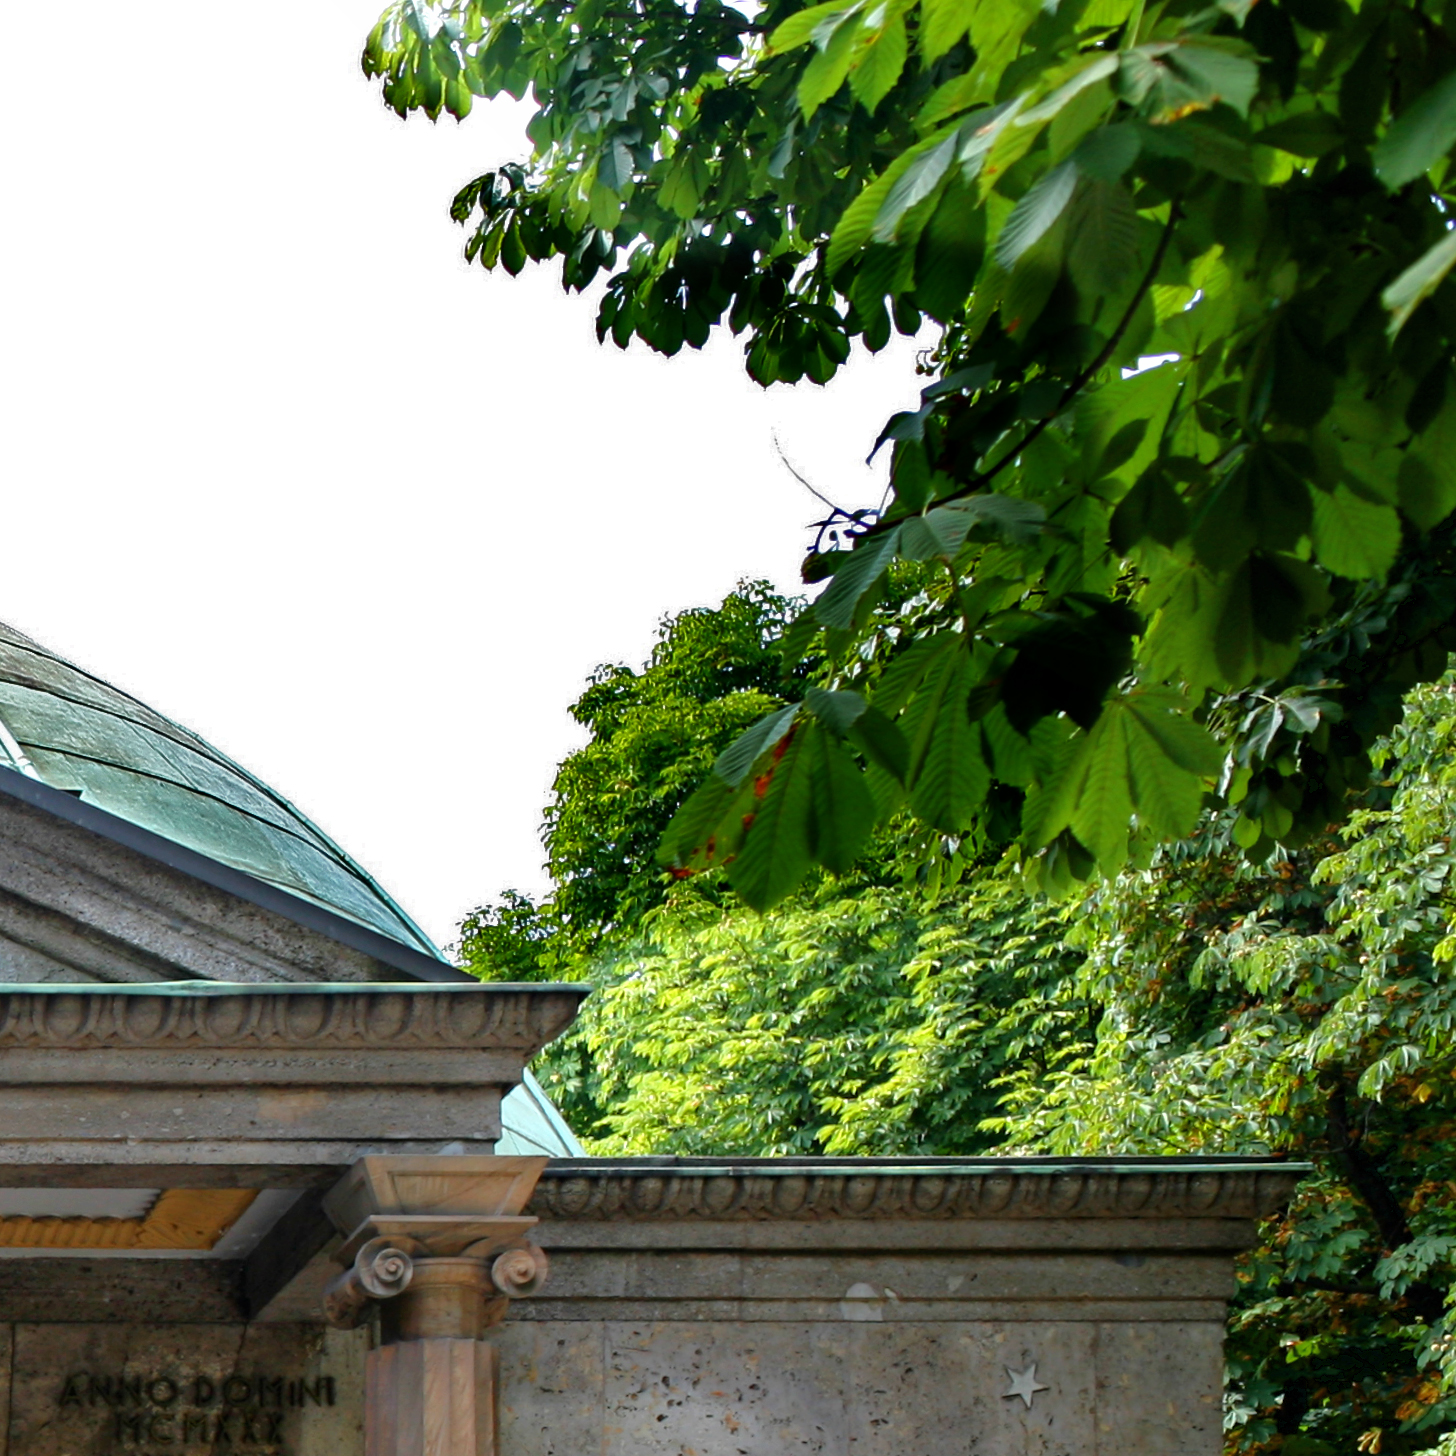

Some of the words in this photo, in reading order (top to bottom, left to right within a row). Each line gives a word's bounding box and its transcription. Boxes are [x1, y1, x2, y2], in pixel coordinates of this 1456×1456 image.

[59, 1376, 177, 1407] ANNO
[195, 1376, 336, 1408] DOMINI
[114, 1413, 283, 1445] MCMXXX
